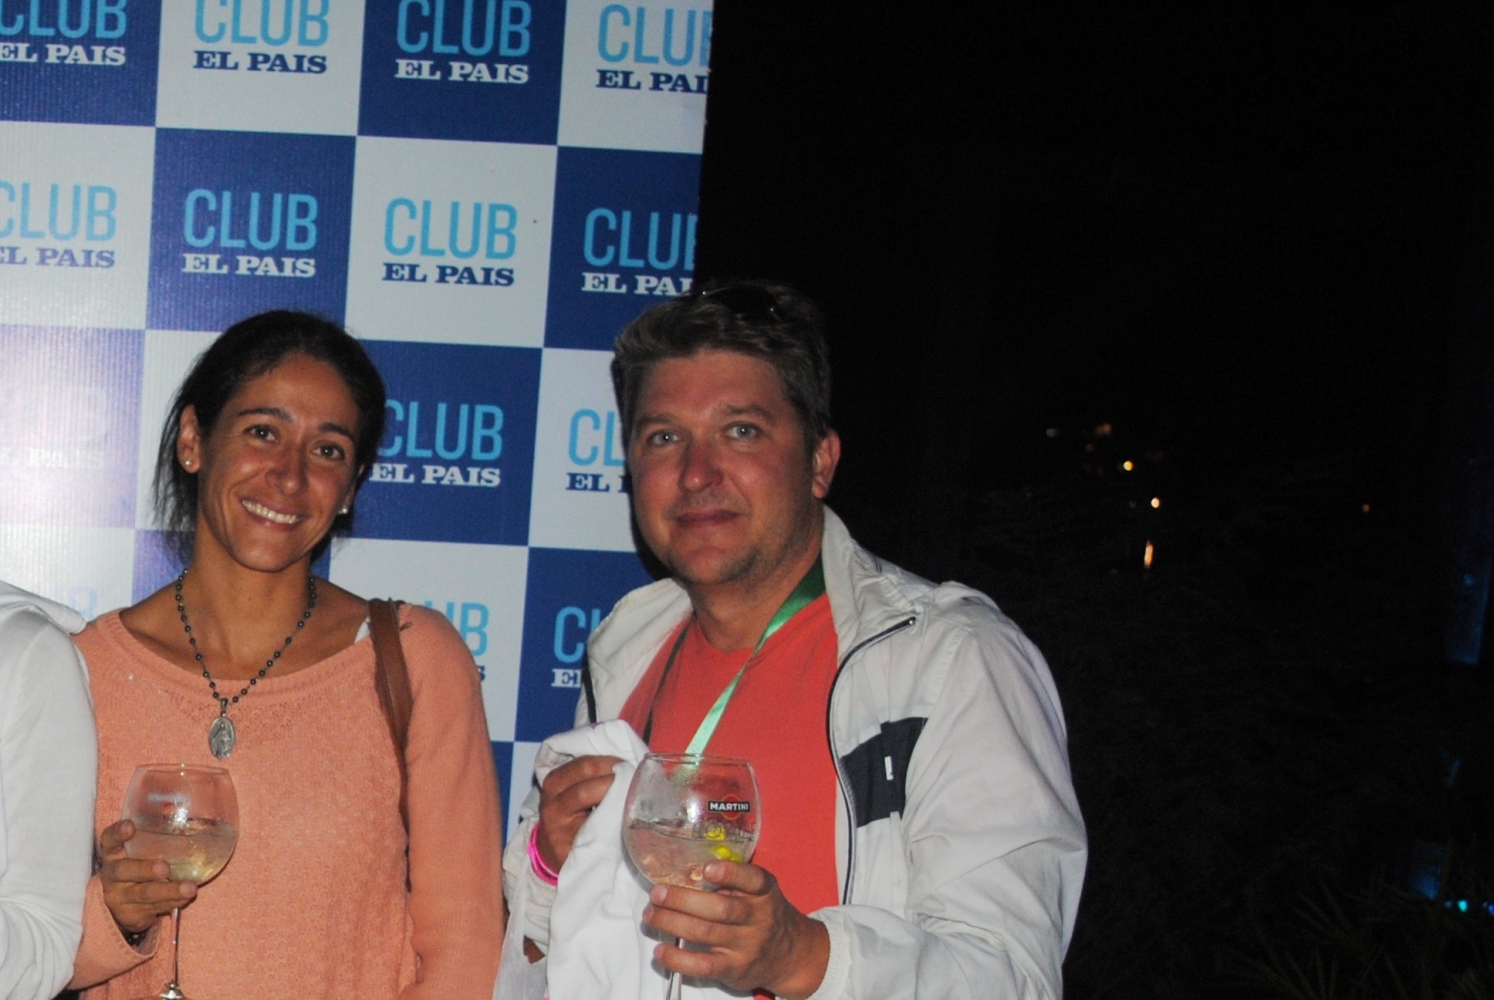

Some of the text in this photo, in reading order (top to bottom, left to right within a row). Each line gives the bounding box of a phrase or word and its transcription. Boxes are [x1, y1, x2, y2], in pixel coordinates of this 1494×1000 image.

[194, 0, 329, 46] CLUB
[395, 0, 532, 57] CLUB
[44, 43, 127, 66] PAIS
[193, 50, 328, 75] EL PAIS
[394, 58, 530, 84] EL PAIS
[595, 68, 708, 94] EL PAI
[182, 188, 319, 251] CLUB
[383, 196, 519, 260] CLUB
[35, 247, 116, 269] PAIS
[181, 253, 316, 278] EL PAIS
[382, 262, 515, 287] EL PAIS
[581, 272, 694, 298] EL PAI
[568, 408, 626, 467] CL
[369, 462, 501, 487] EL PAIS
[566, 473, 610, 494] EL
[709, 802, 749, 811] MARTINI
